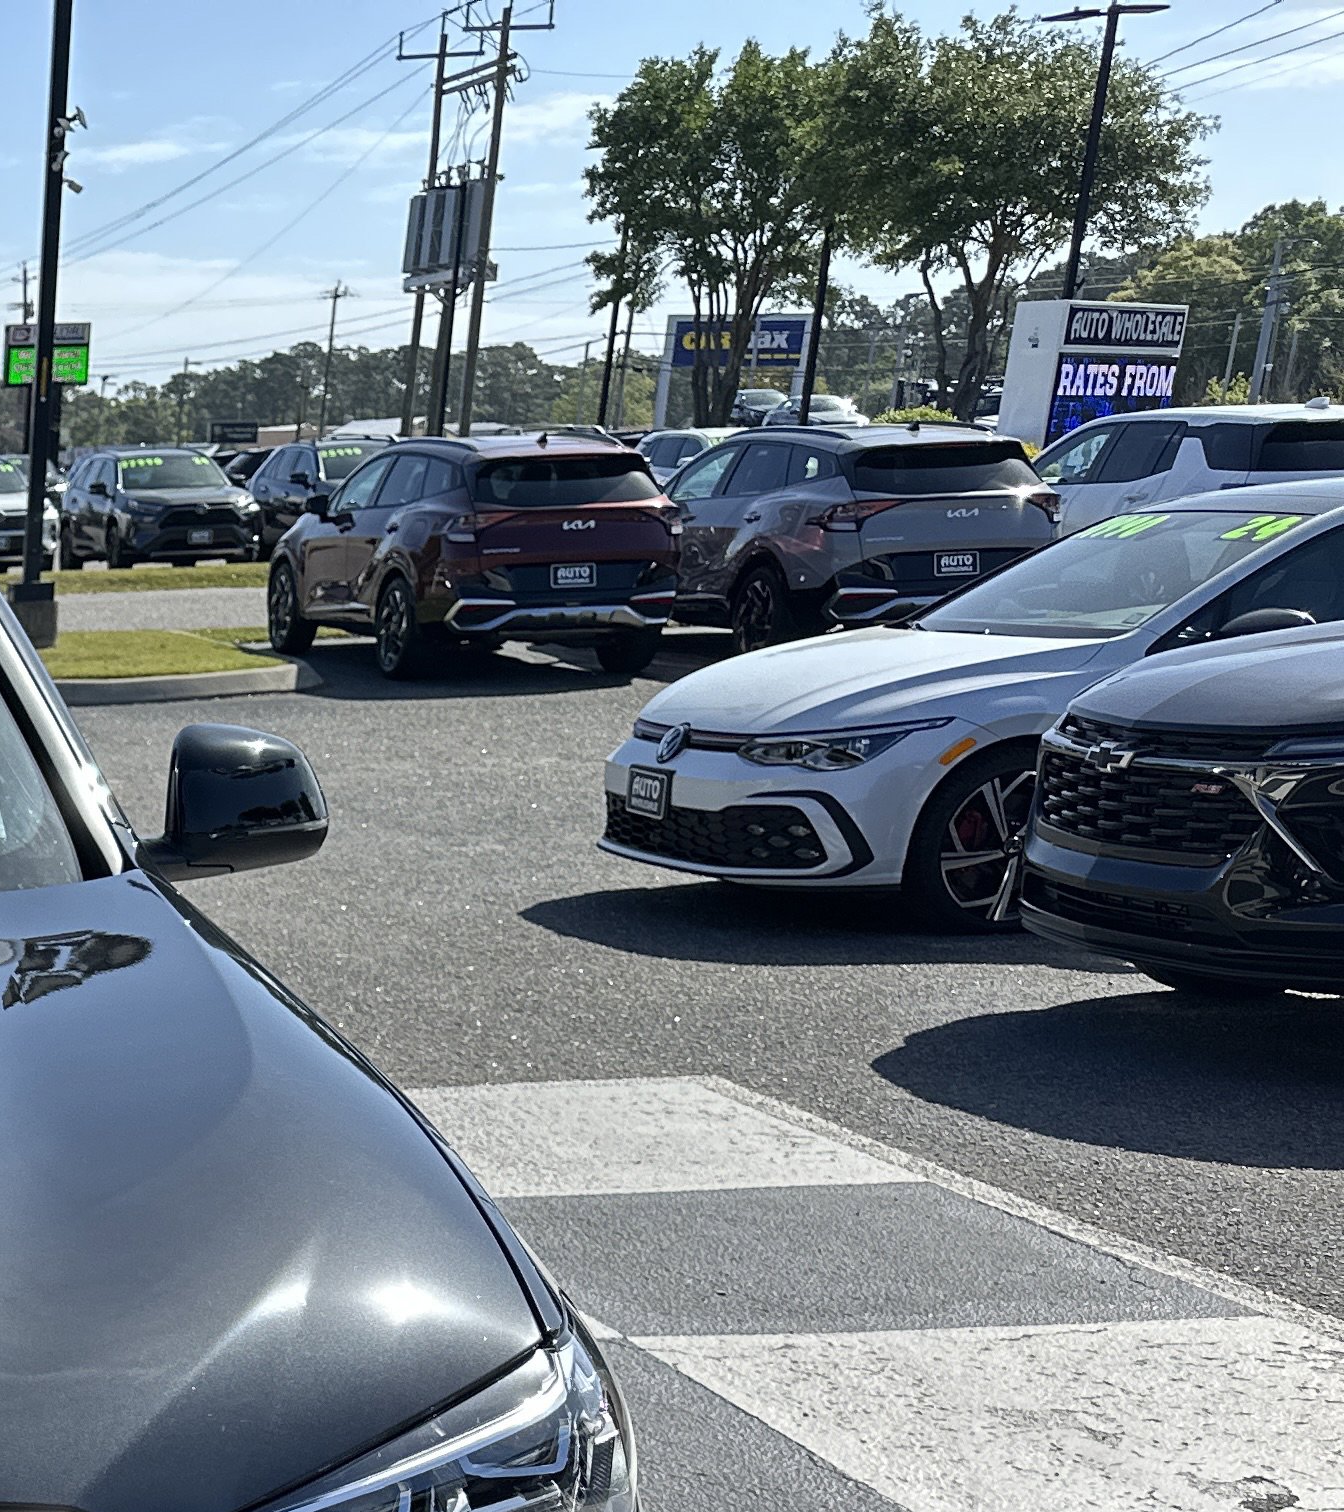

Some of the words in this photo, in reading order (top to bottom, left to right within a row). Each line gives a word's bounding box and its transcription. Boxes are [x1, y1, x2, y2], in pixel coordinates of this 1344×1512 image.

[1071, 311, 1110, 341] AUTO
[1112, 310, 1184, 343] WHOLESALE
[1057, 364, 1119, 396] RATES
[1121, 365, 1176, 397] FROM
[1219, 516, 1302, 542] 24
[557, 566, 590, 579] AUTO
[940, 555, 973, 567] AUTO
[632, 775, 661, 800] AUTO
